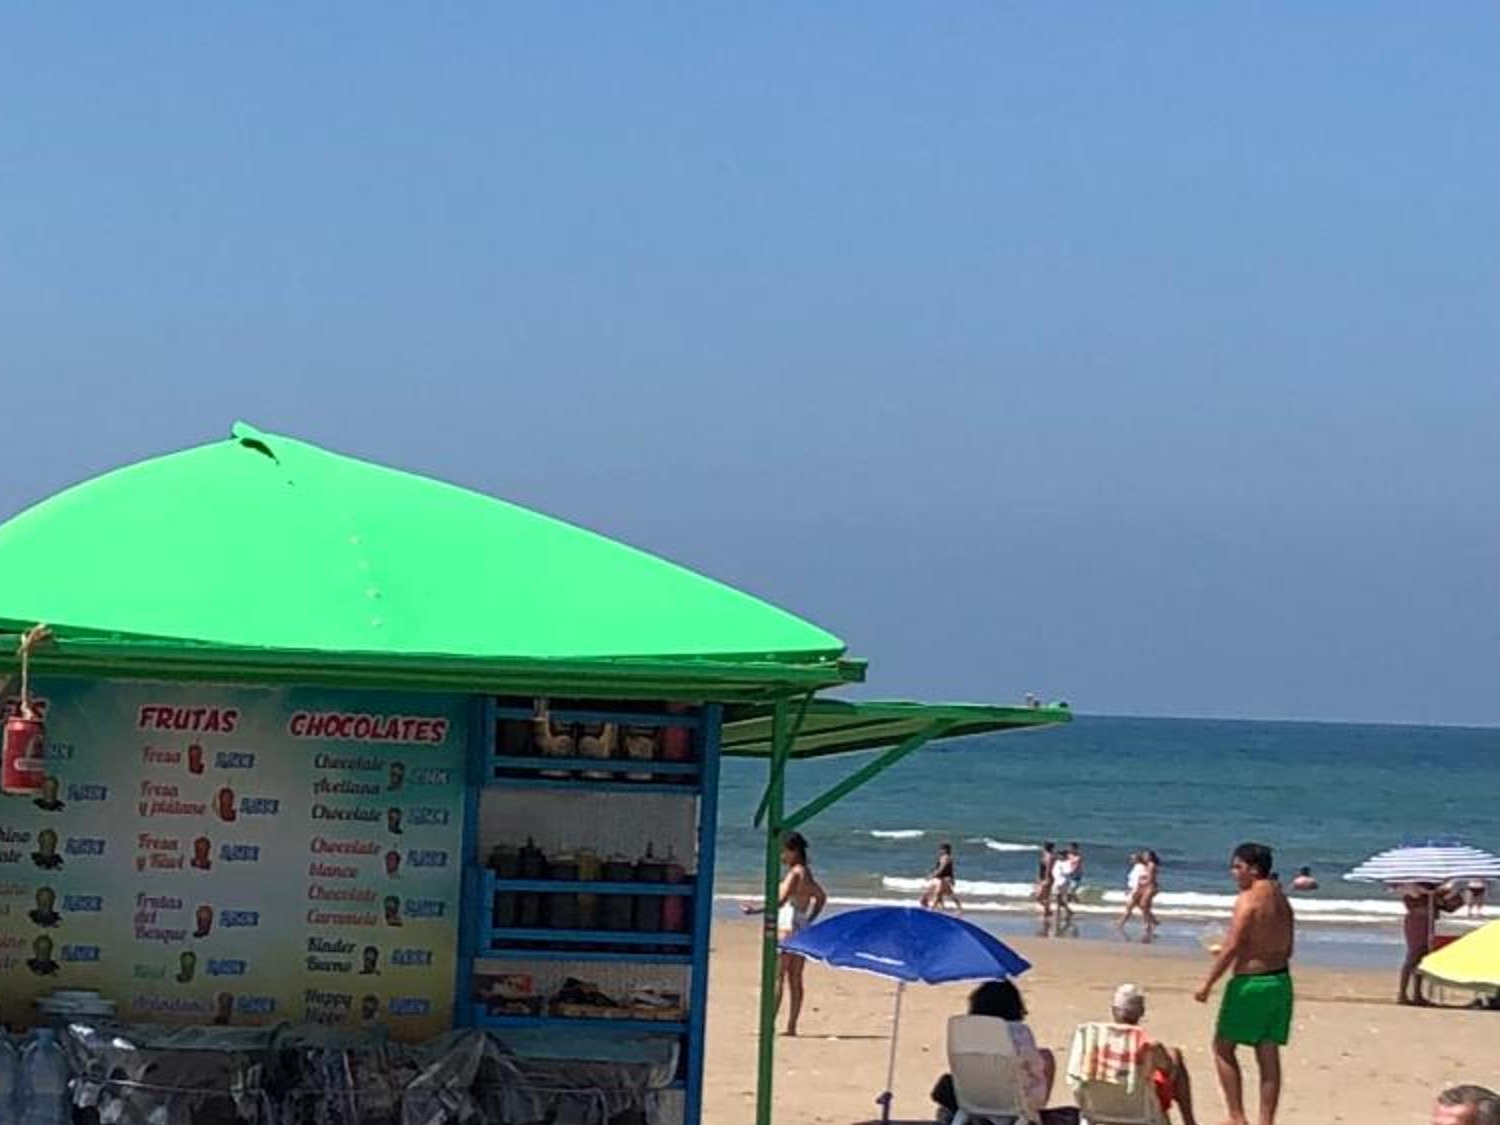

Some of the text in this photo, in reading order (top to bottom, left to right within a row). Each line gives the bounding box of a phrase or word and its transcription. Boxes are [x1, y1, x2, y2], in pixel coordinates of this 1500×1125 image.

[140, 706, 238, 733] FRUTAS
[290, 713, 447, 742] CHOCOLATES
[314, 753, 384, 771] Chocolate
[312, 805, 382, 822] Chocolate
[311, 837, 380, 854] Chocolate
